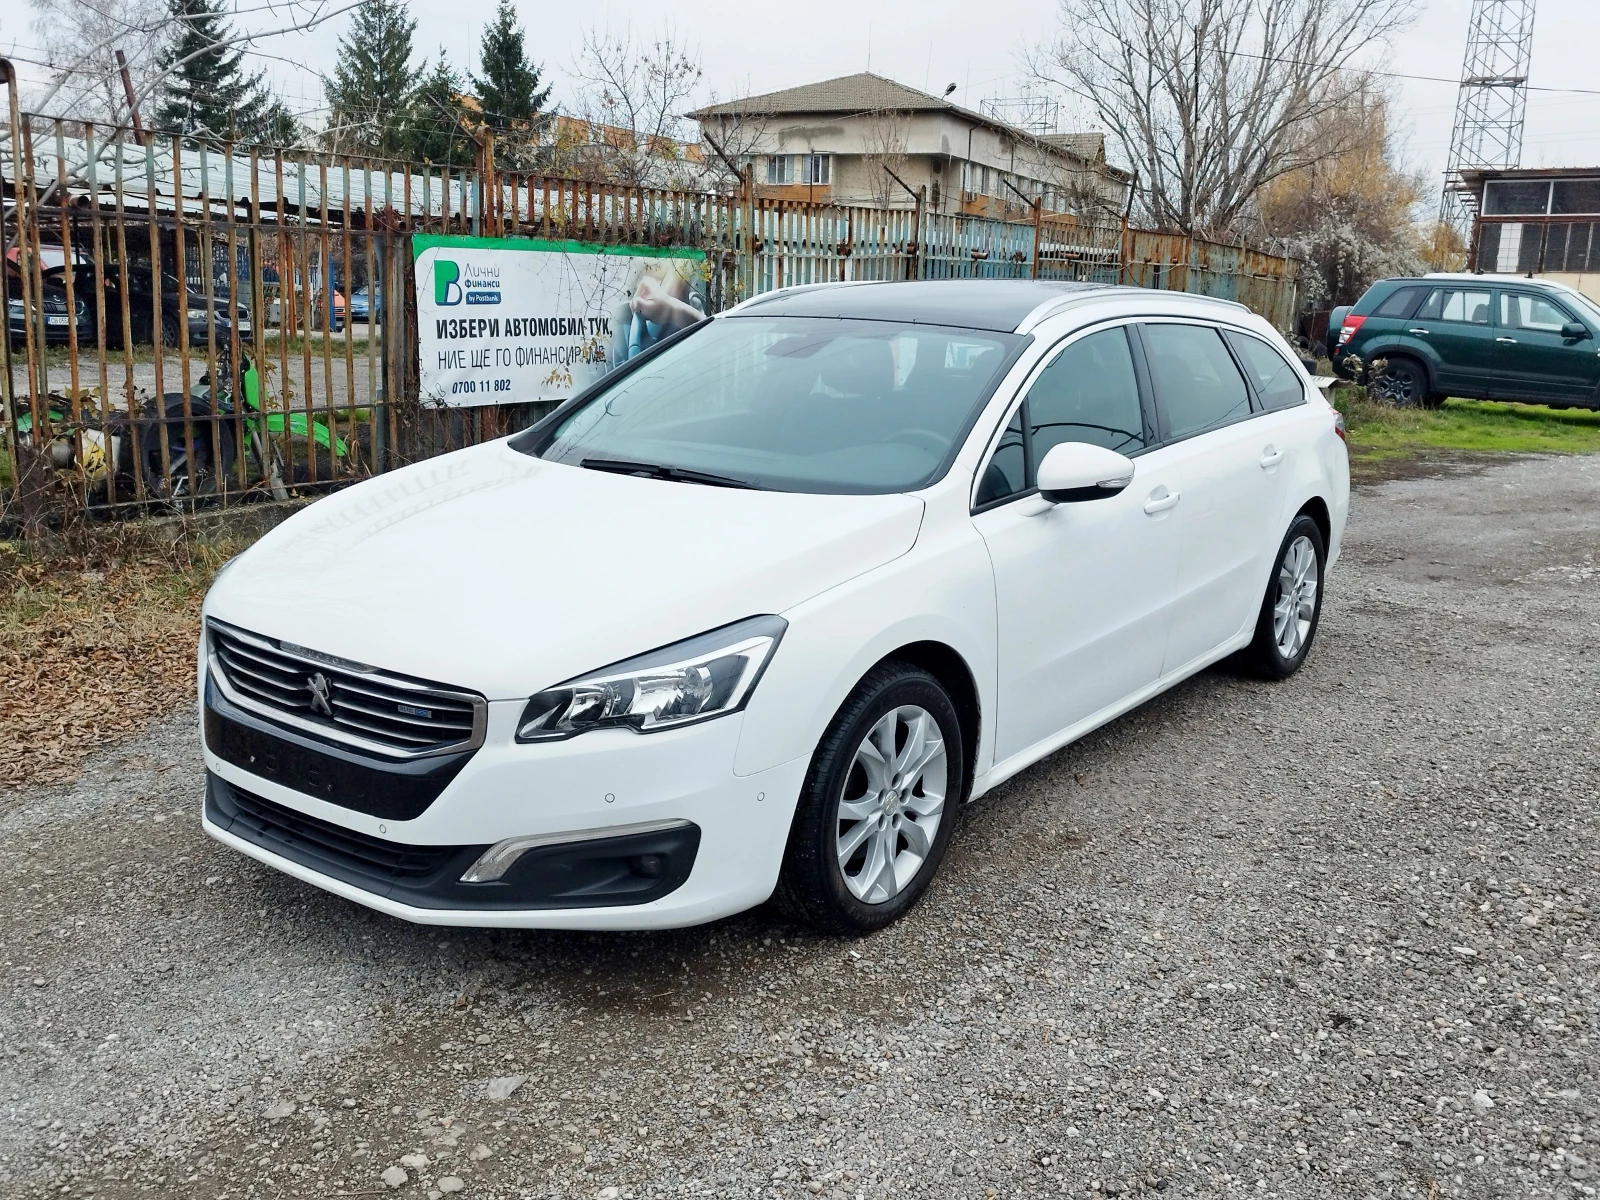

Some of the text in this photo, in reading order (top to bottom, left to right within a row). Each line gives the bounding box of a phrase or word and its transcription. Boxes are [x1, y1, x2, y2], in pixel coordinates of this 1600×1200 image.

[464, 263, 500, 277] Лични
[465, 279, 500, 288] Финанси
[469, 295, 475, 303] by
[436, 317, 613, 340] ИЗБЕРИ АВТОМОБИЛ ТУК,
[438, 350, 466, 370] НИЕ
[470, 349, 491, 371] ЩЕ
[496, 348, 511, 367] ГО
[452, 379, 511, 394] 0700 11 802
